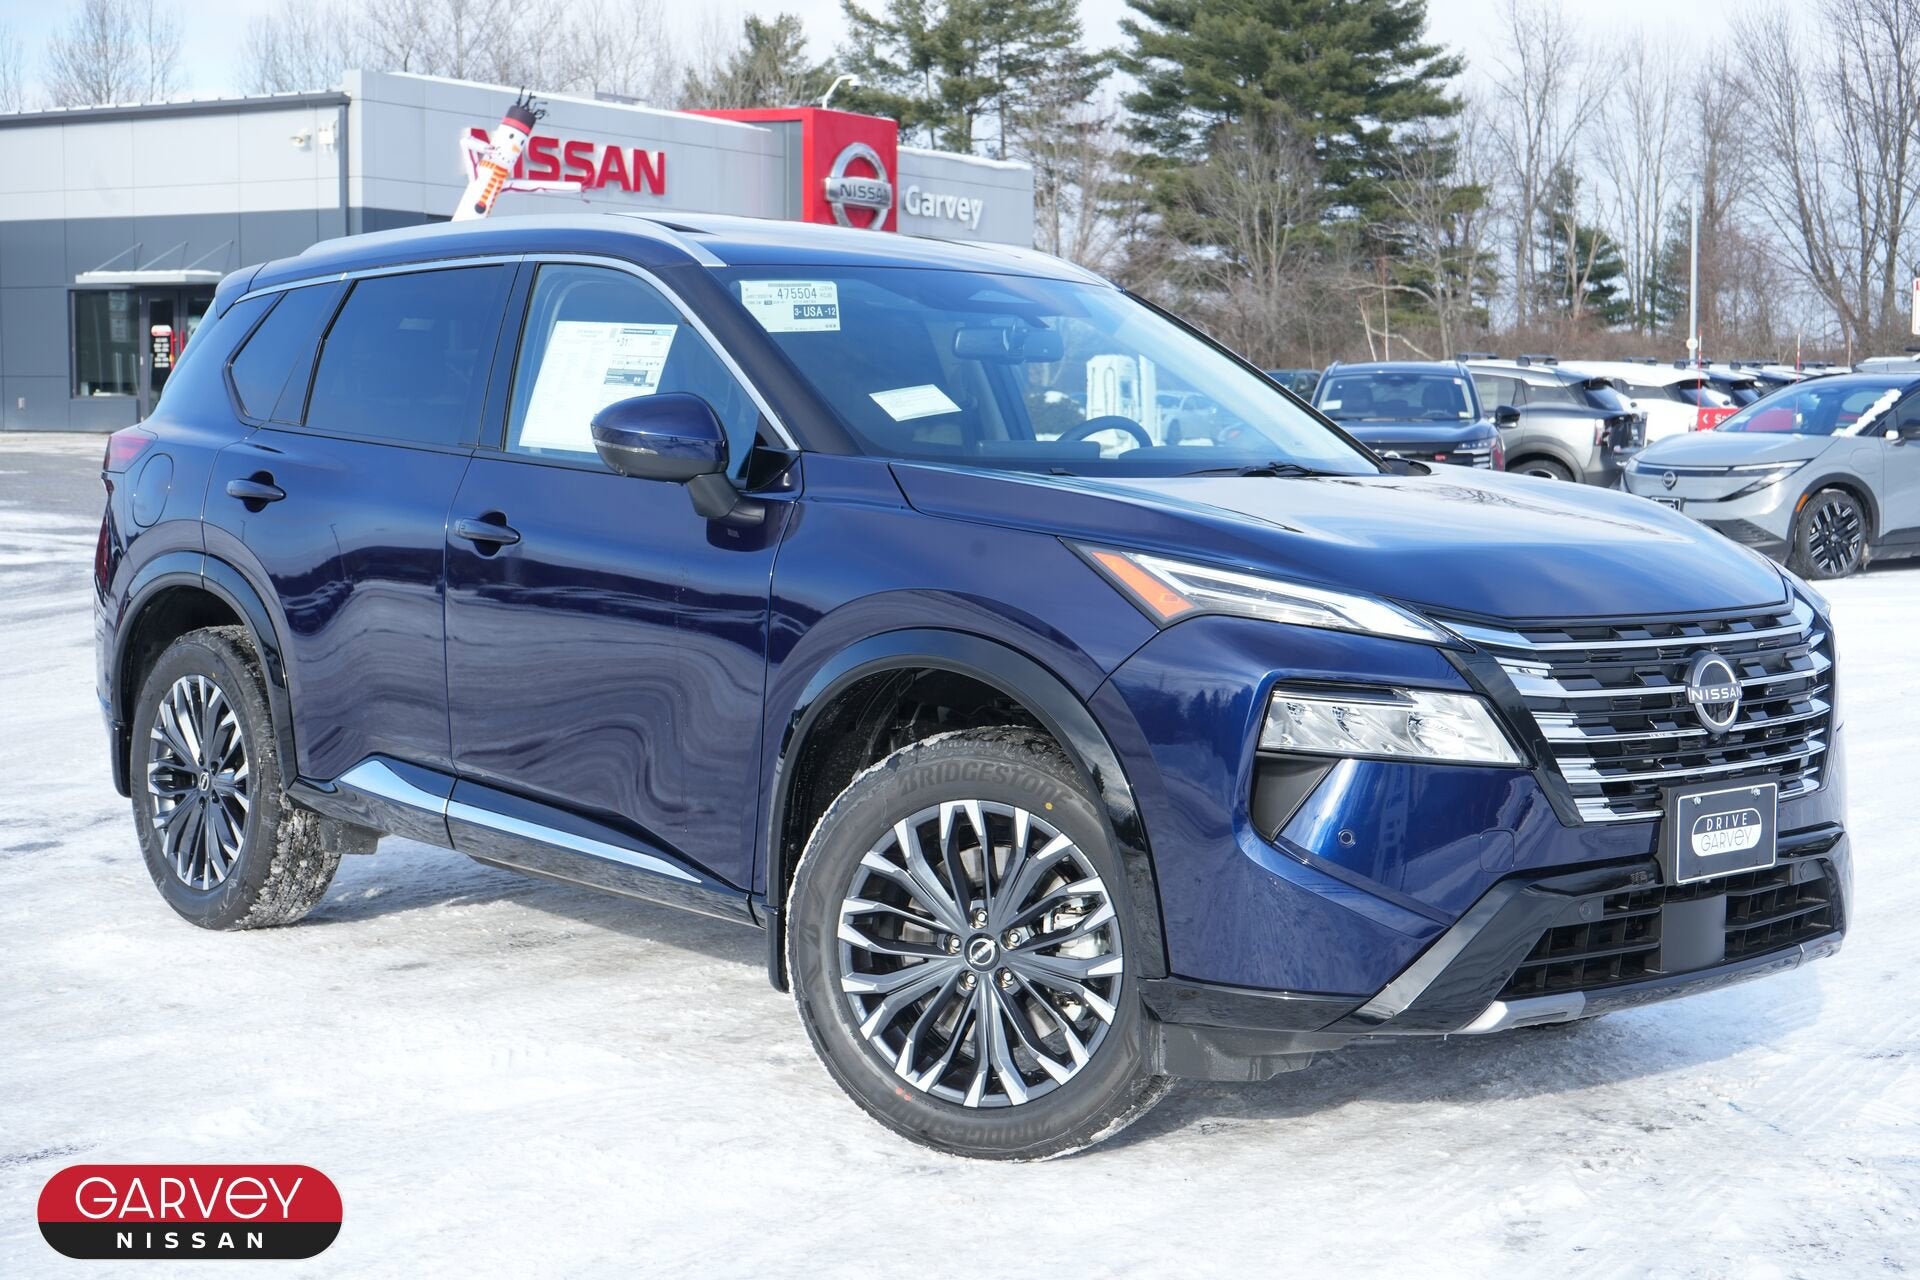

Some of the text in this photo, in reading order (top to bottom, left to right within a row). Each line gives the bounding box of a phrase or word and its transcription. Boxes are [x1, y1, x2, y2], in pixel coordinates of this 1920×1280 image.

[470, 127, 666, 196] SSAN
[904, 184, 984, 231] Garvey
[777, 287, 818, 300] 475504
[803, 305, 823, 317] USA
[1690, 682, 1743, 701] NISSAN
[1706, 812, 1748, 832] DRIVE
